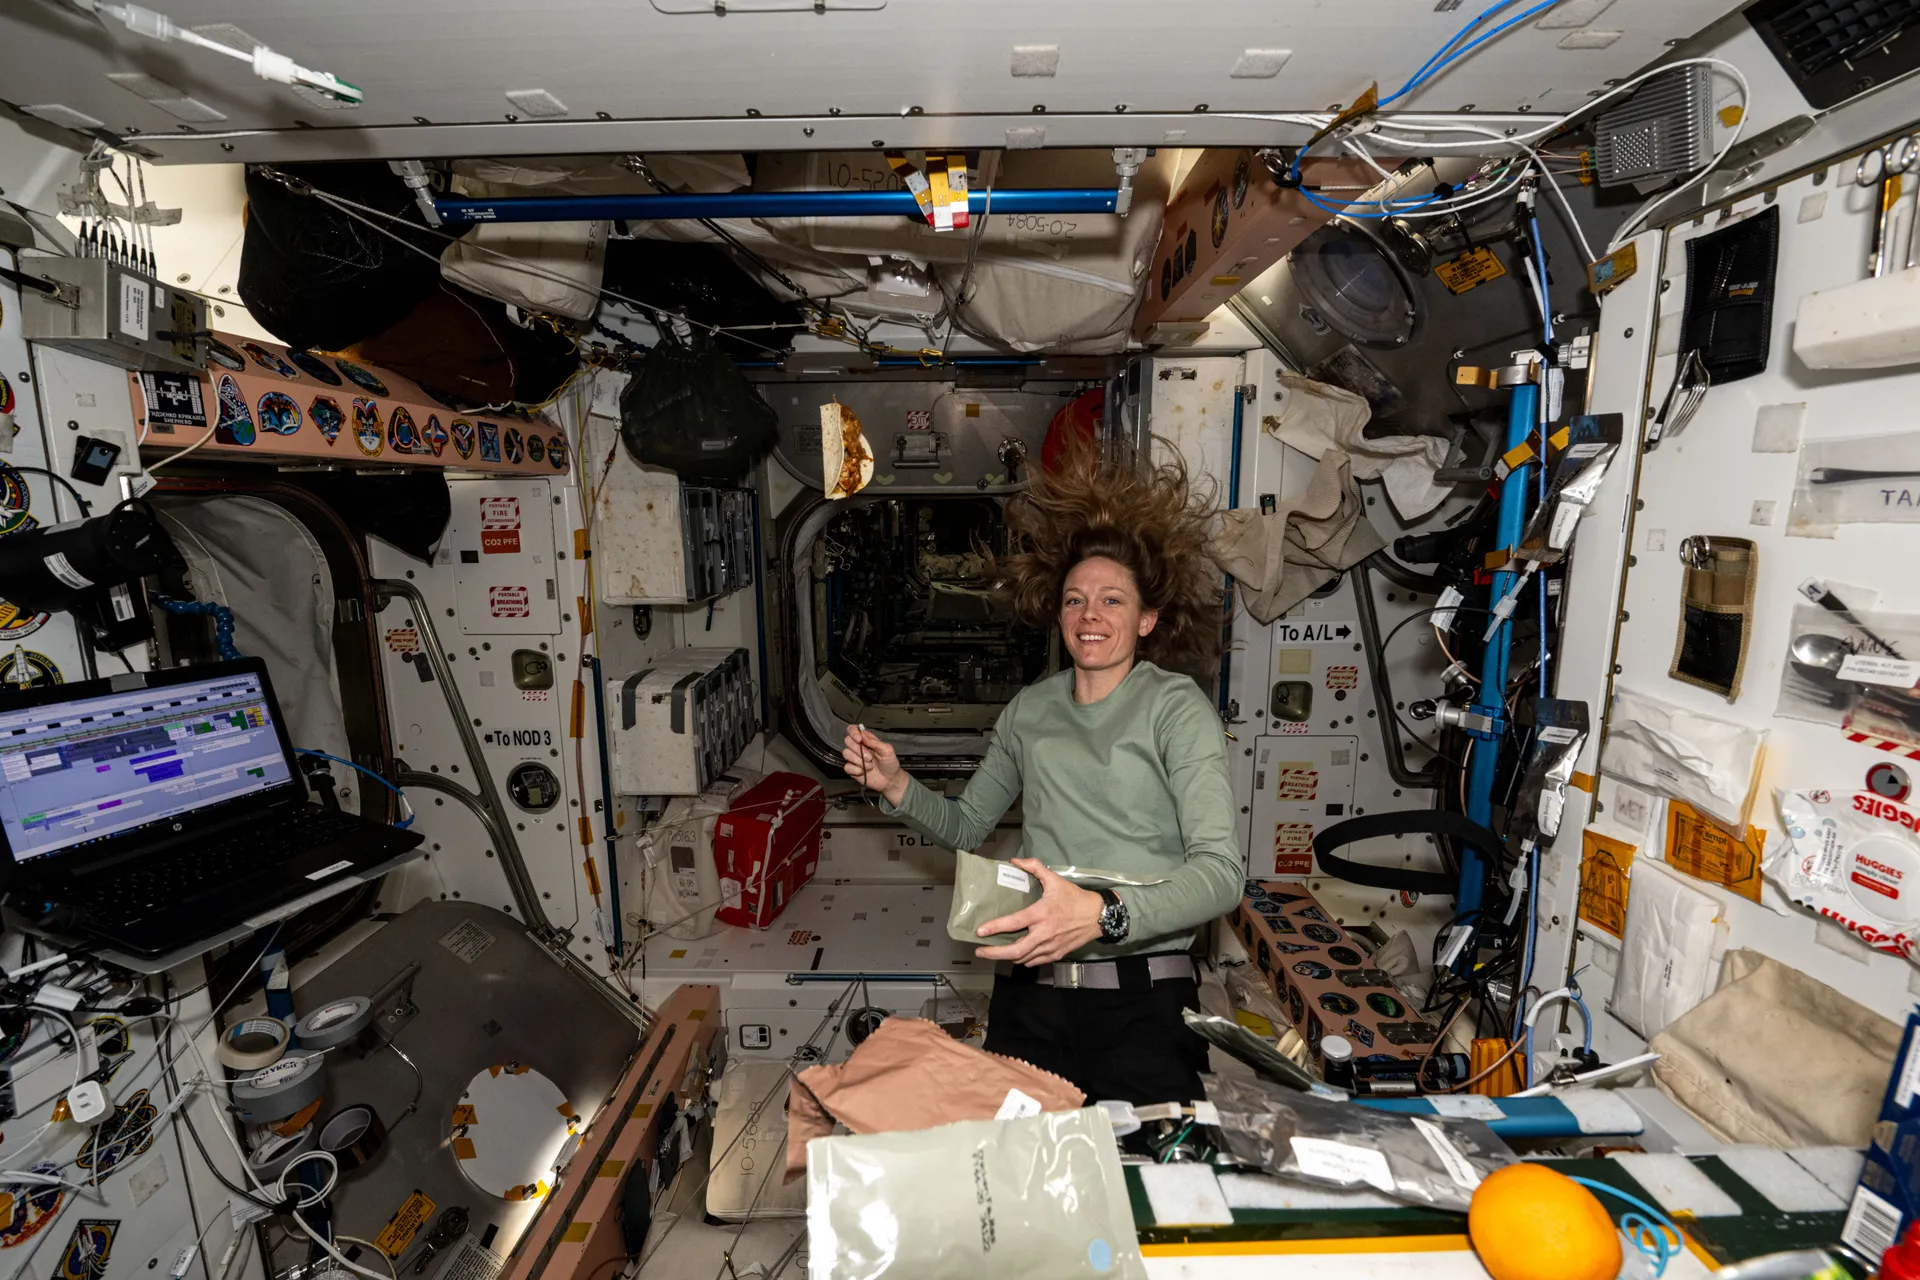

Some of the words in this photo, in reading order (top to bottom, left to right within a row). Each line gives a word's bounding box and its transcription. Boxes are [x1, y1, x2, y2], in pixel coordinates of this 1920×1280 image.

[1451, 257, 1478, 273] WARNING
[910, 415, 926, 425] EXIT
[1881, 489, 1920, 507] TA
[484, 538, 502, 546] CO2
[503, 537, 519, 546] PFE
[1280, 625, 1299, 641] To
[1303, 624, 1333, 641] A/L
[494, 731, 510, 747] To
[513, 730, 541, 746] NOD
[543, 730, 552, 746] 3
[1284, 781, 1314, 789] BREATHING
[1619, 799, 1645, 822] WET
[897, 834, 915, 847] To
[920, 835, 934, 847] L
[1294, 860, 1310, 868] PFE
[1855, 854, 1904, 880] HUGGIES
[400, 1213, 424, 1242] WARNING
